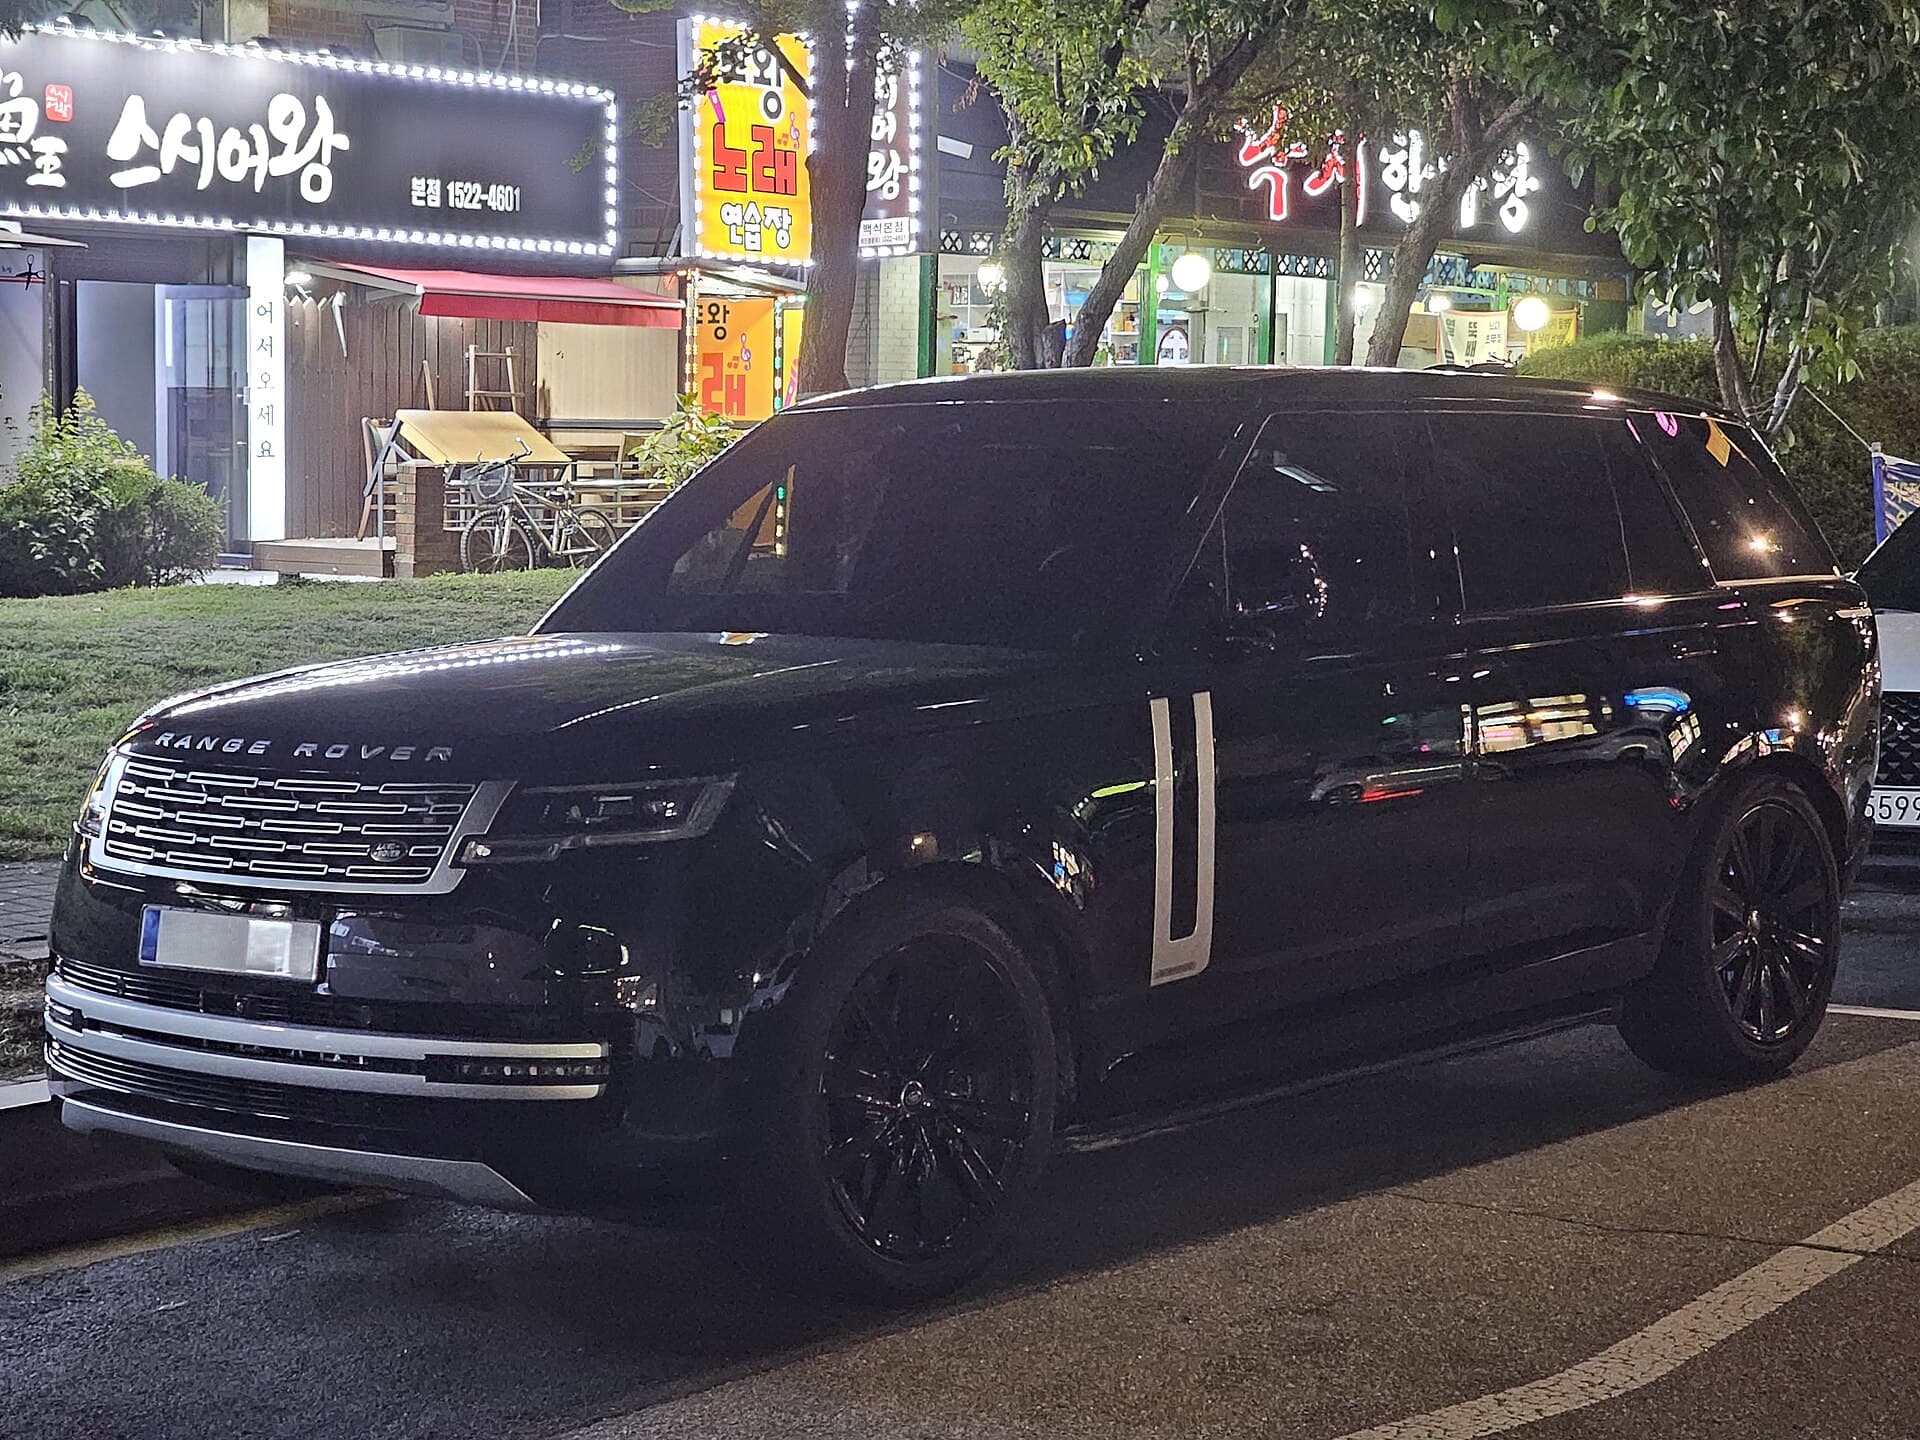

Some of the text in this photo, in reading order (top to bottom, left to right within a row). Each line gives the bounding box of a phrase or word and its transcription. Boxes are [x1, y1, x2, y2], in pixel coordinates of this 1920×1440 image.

[718, 41, 784, 121] 왕
[107, 93, 349, 203] 스시어왕
[712, 122, 797, 196] 노래
[411, 176, 521, 212] 본점 1522-4601
[719, 201, 793, 251] 연습장
[256, 301, 276, 458] 어서오세요
[702, 352, 746, 417] 래
[155, 731, 454, 762] RANGE ROVER
